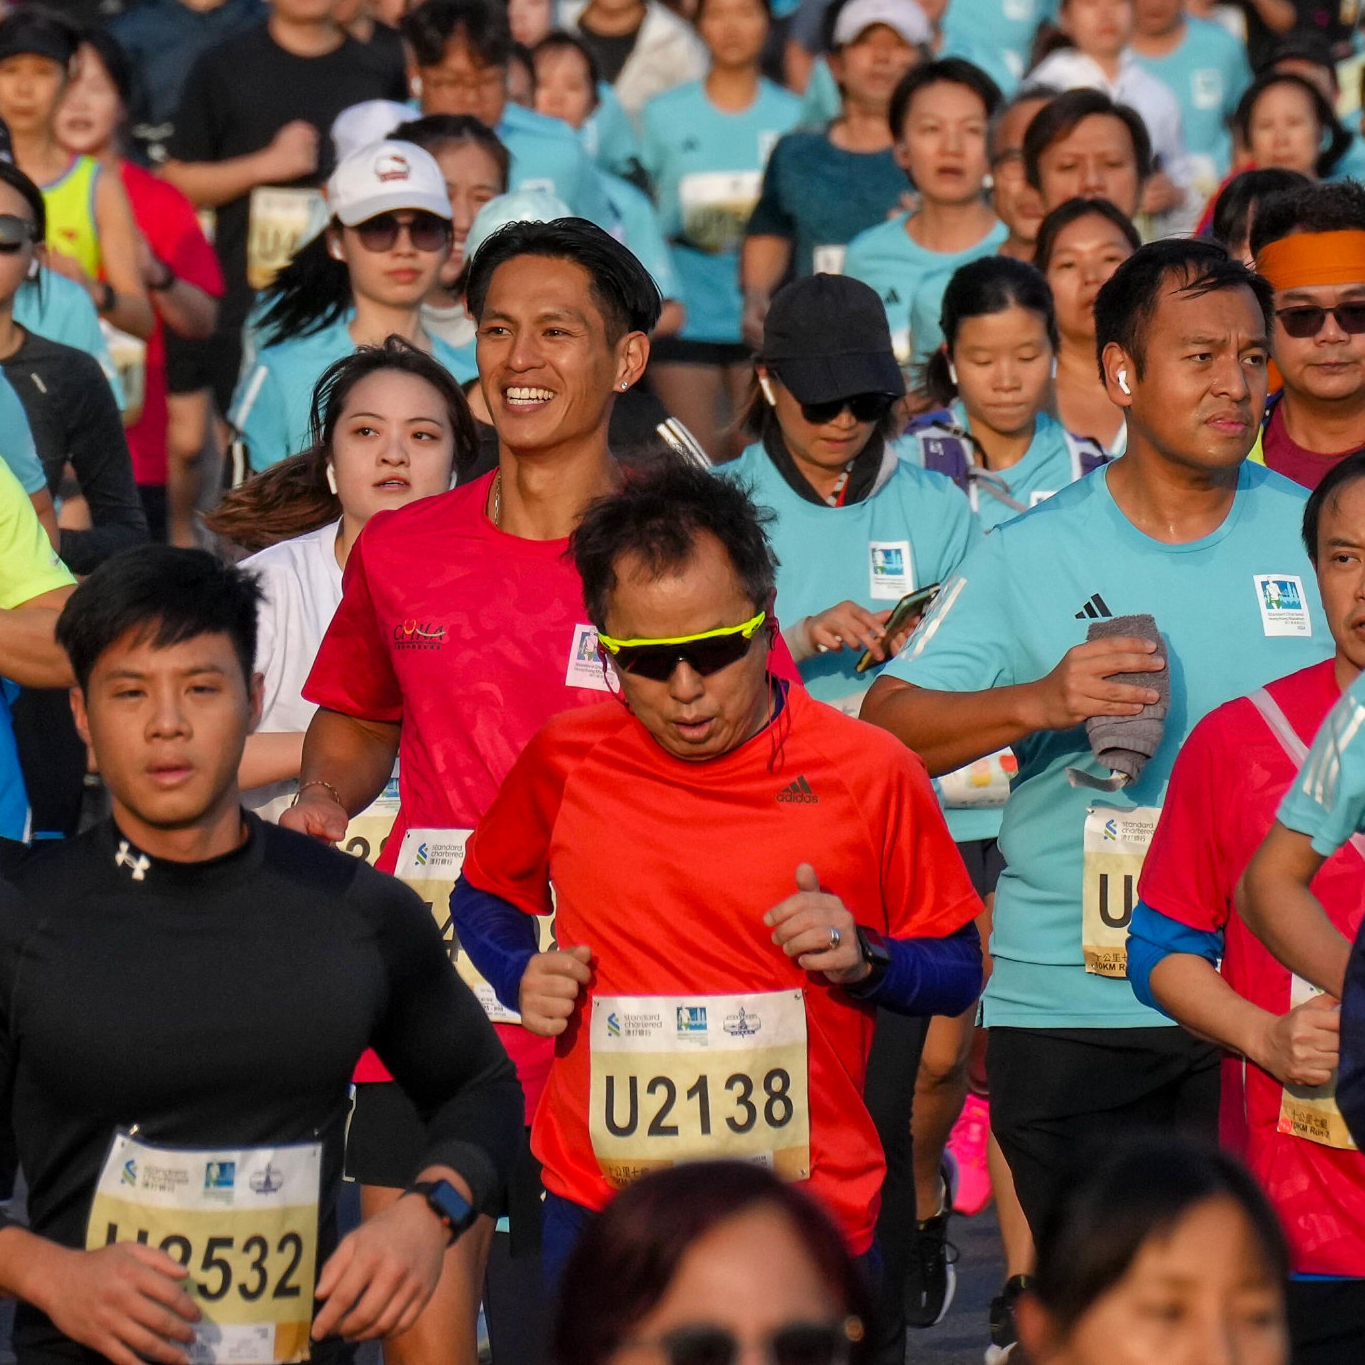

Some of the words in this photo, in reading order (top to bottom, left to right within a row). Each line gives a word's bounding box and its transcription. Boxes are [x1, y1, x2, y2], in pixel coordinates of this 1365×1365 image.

[776, 792, 818, 803] adidas
[623, 1013, 660, 1021] standard
[624, 1020, 663, 1029] chartered
[605, 1068, 794, 1138] U2138
[106, 1222, 303, 1303] 532
